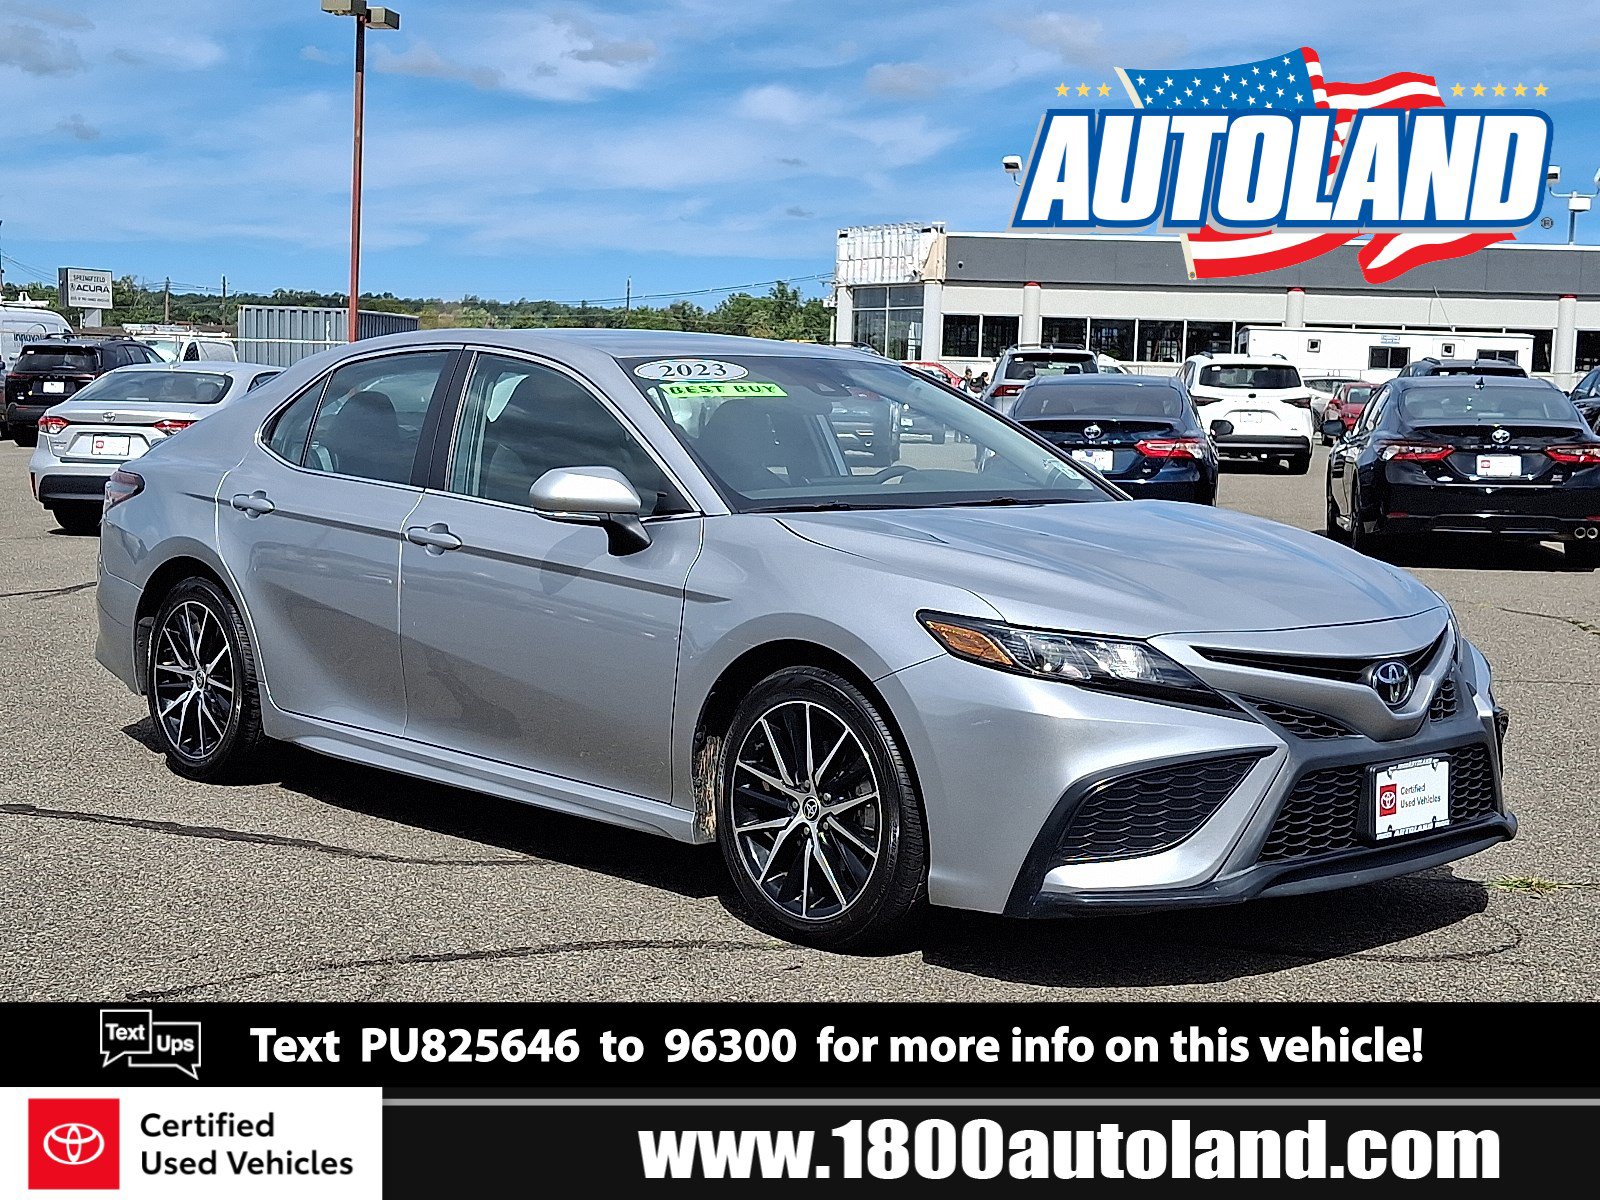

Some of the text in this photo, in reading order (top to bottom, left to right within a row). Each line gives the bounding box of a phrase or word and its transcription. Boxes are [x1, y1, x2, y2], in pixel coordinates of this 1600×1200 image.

[76, 284, 110, 293] ACURA
[658, 363, 728, 378] 2023
[669, 384, 776, 395] BEST BUY
[1401, 783, 1425, 795] Certified
[1401, 795, 1441, 808] Used Vehicles
